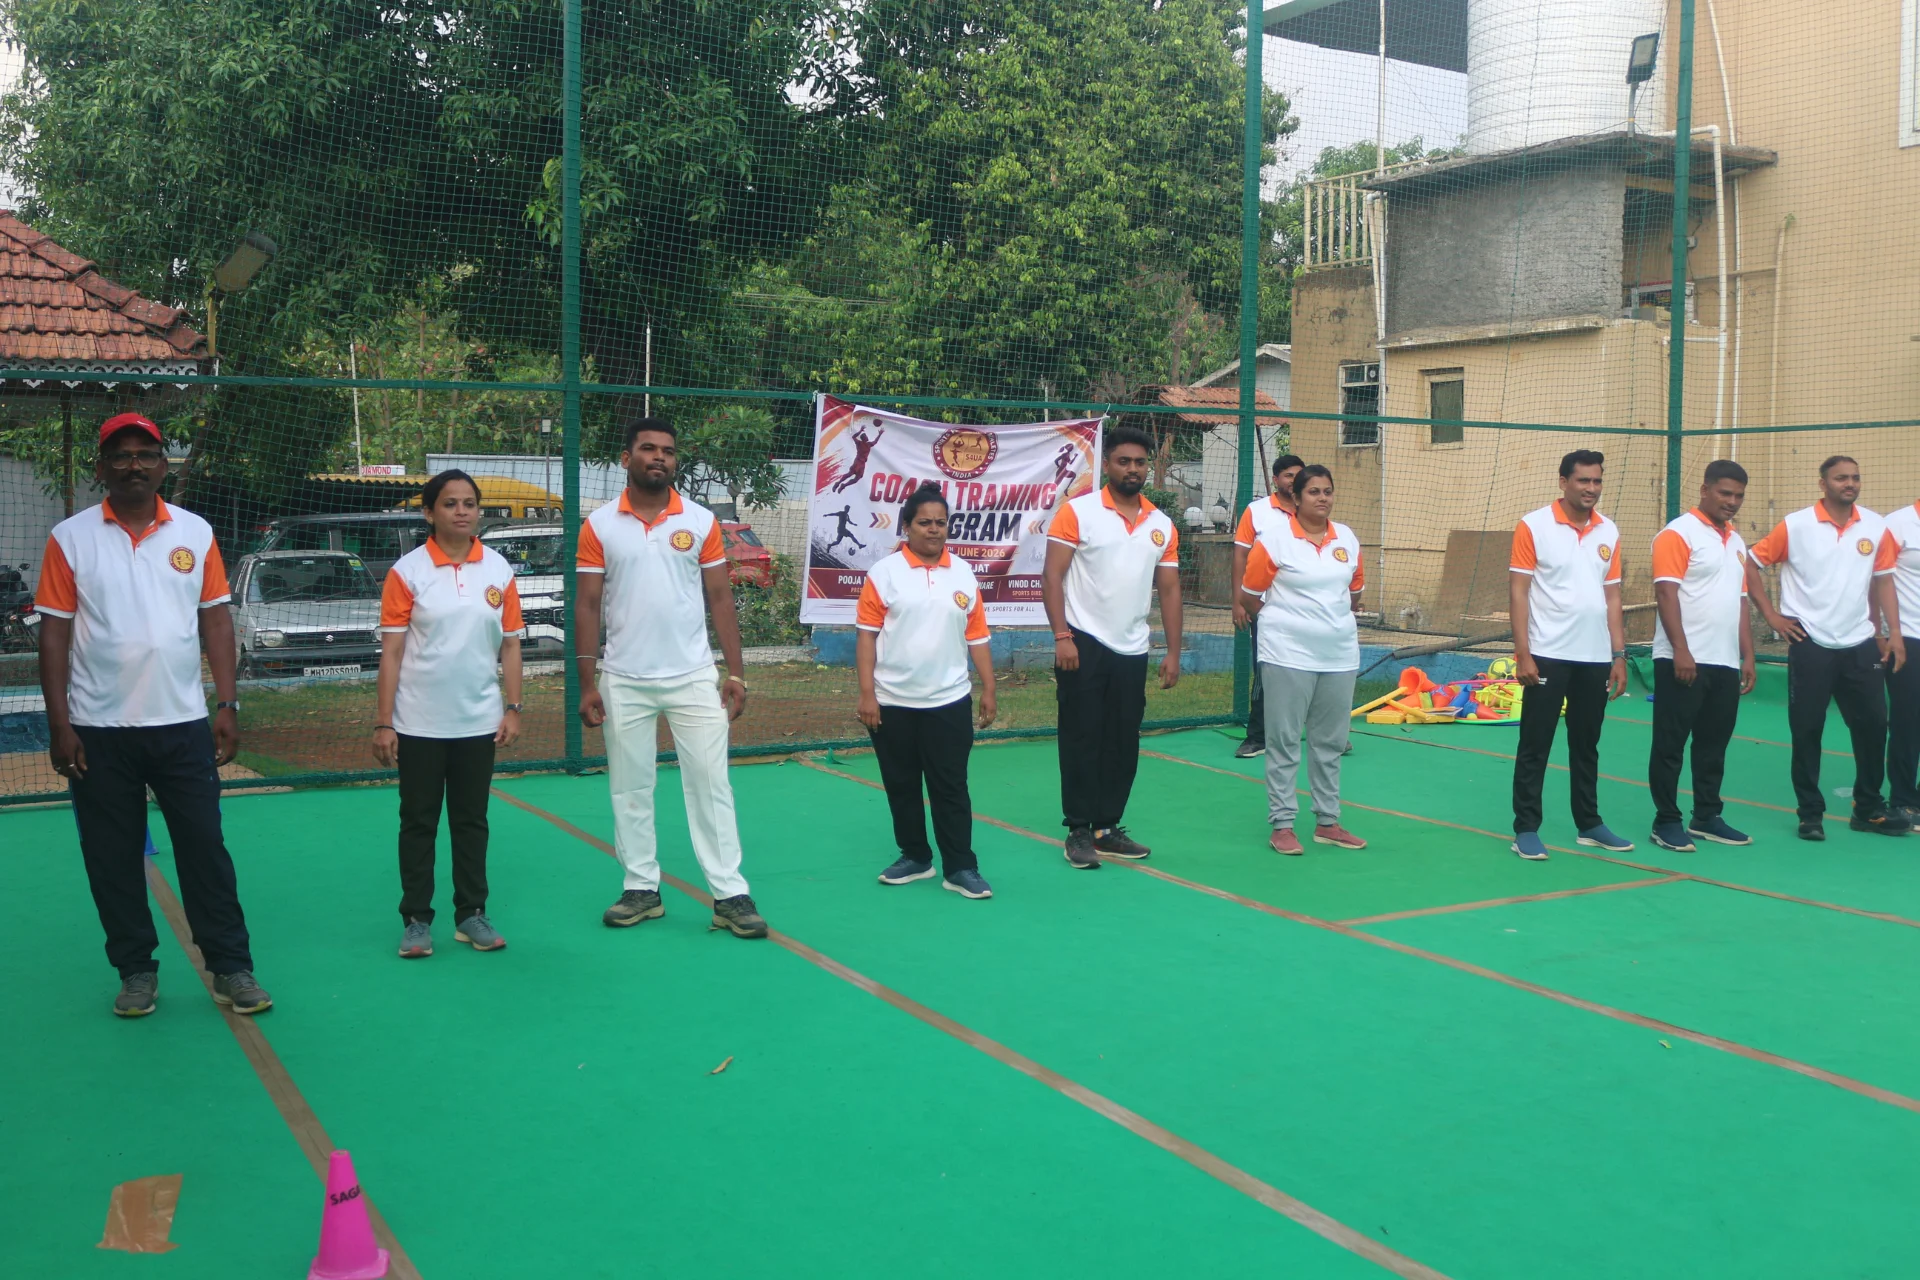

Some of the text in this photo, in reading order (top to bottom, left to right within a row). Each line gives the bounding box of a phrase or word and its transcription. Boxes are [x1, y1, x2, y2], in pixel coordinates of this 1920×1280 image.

[965, 453, 983, 462] S4UA
[952, 471, 972, 479] INDIA
[955, 481, 1058, 511] TRAINING
[957, 547, 979, 557] JUNE
[981, 548, 1006, 558] 2026
[838, 575, 862, 585] POOJA
[1008, 579, 1029, 589] VINOD
